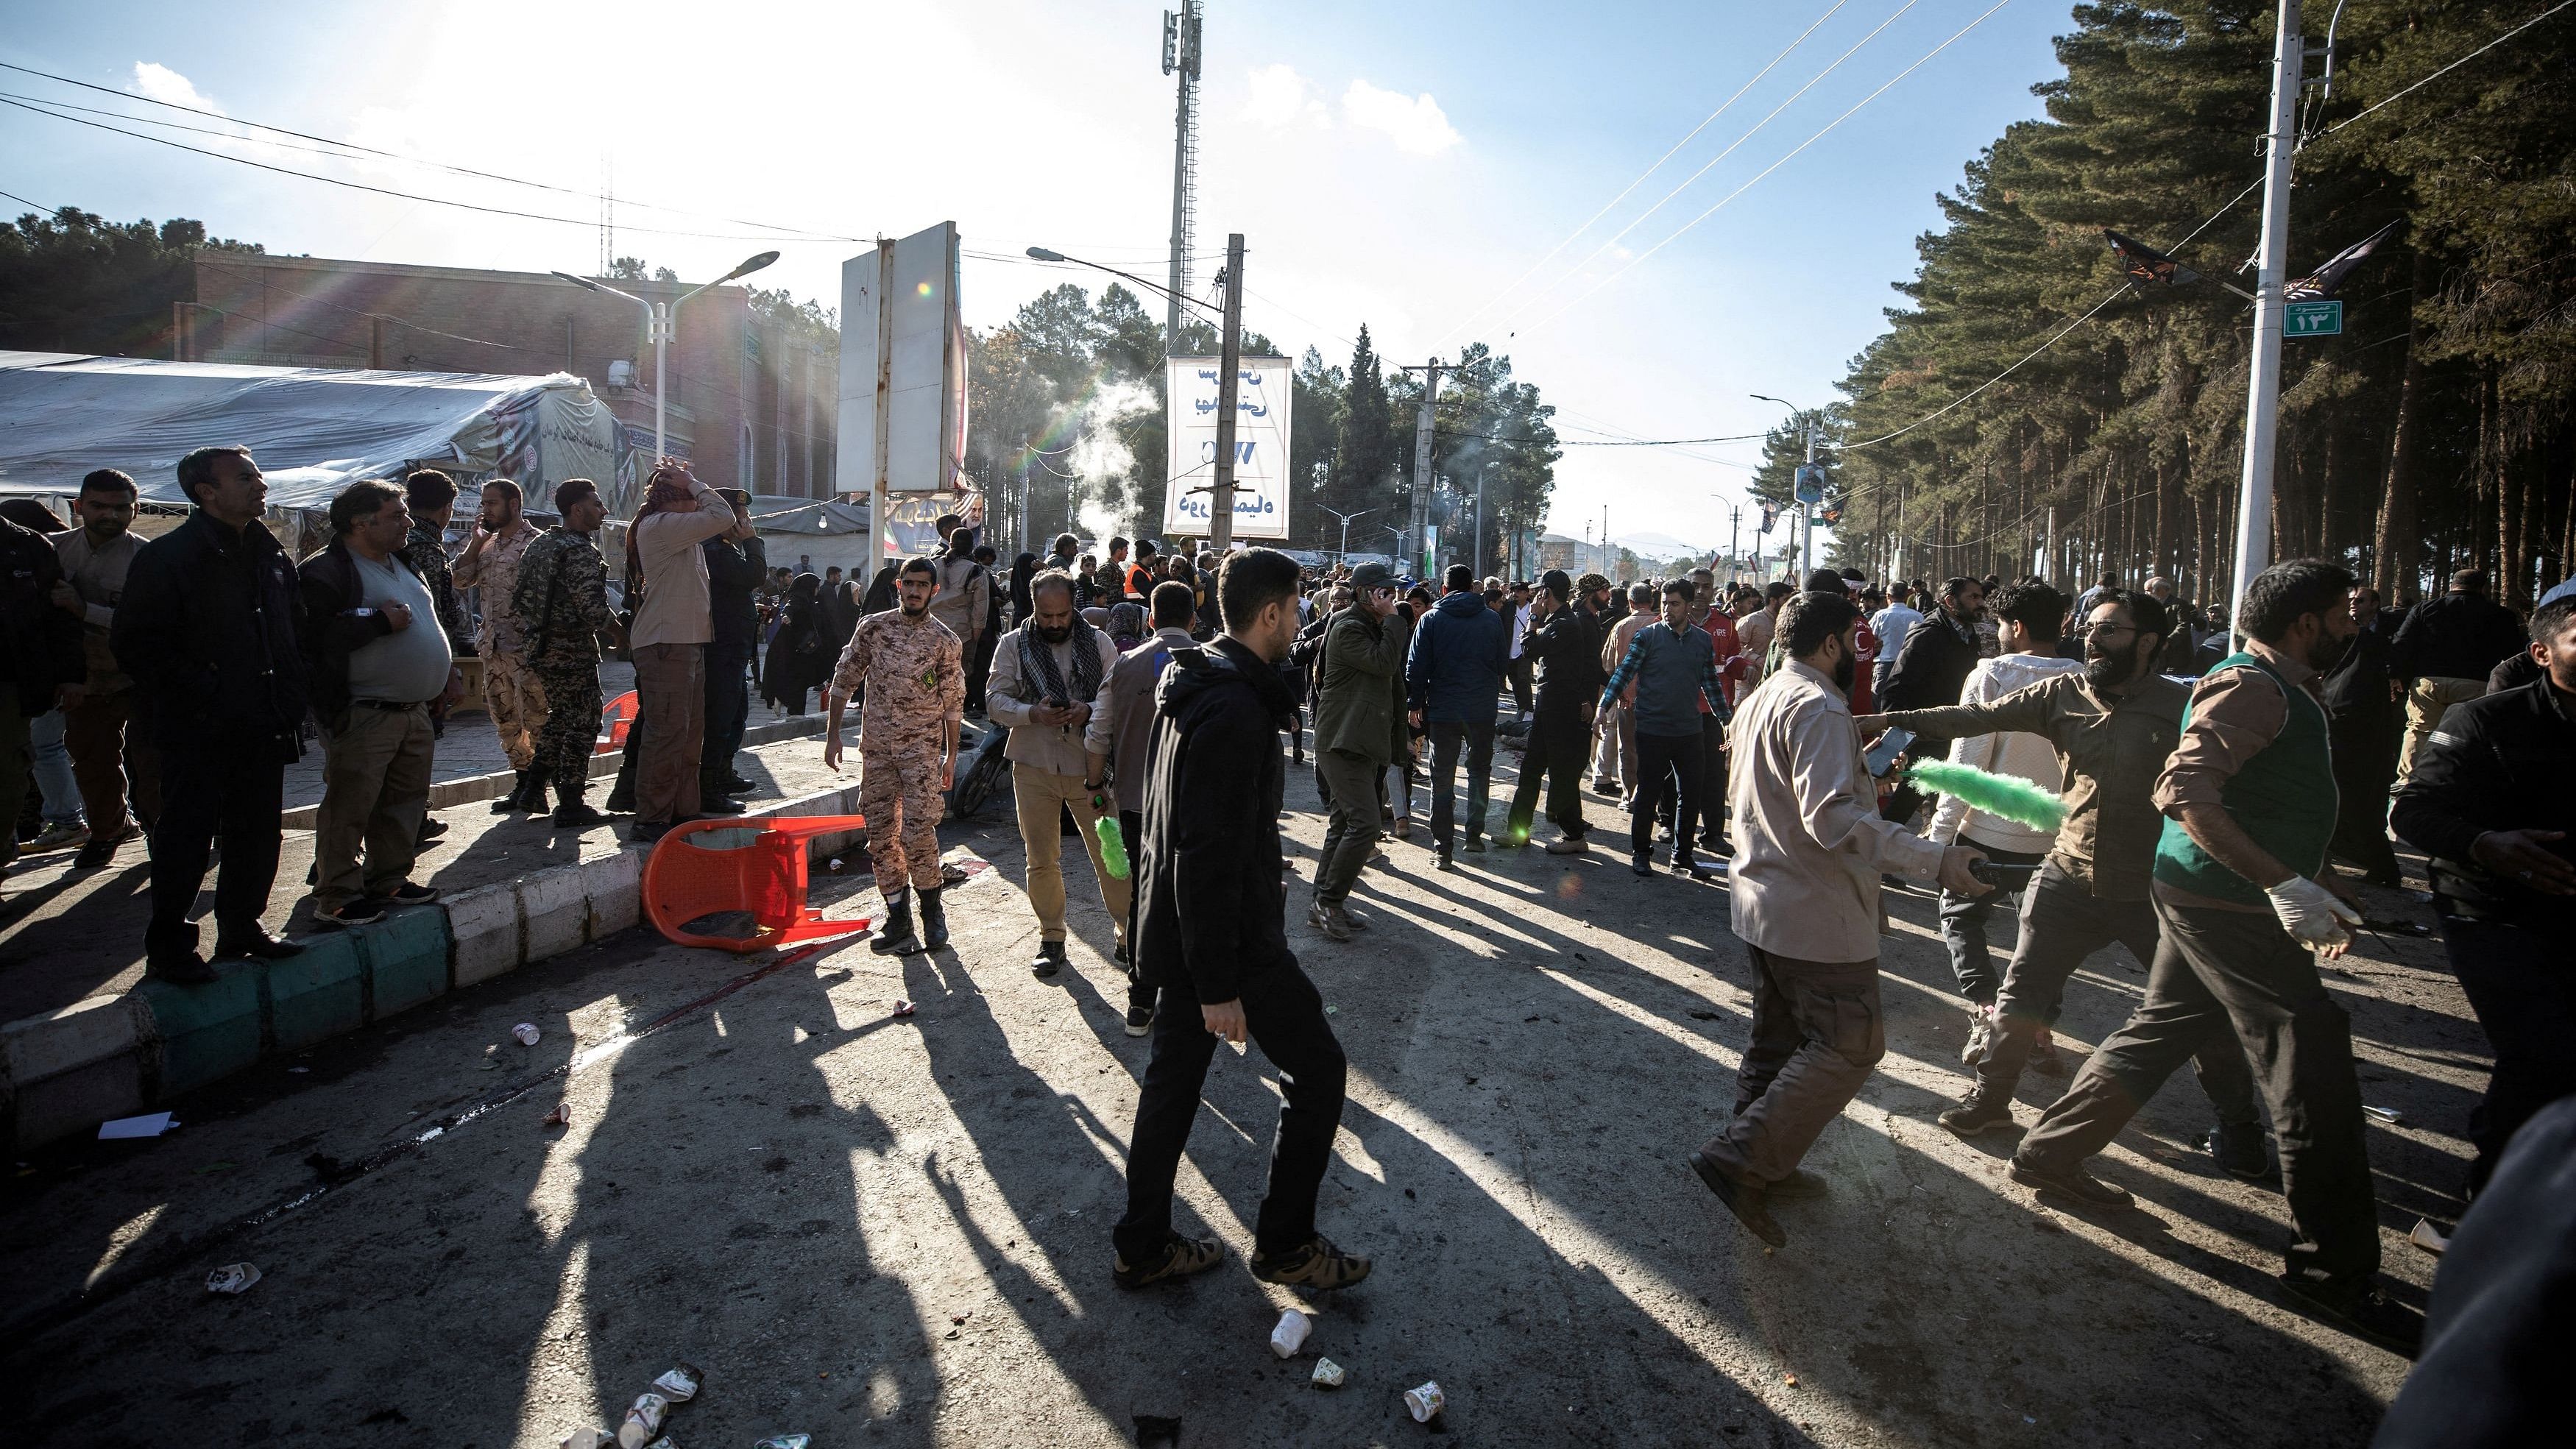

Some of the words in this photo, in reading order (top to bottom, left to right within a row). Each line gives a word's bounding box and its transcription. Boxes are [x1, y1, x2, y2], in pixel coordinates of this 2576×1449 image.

[2296, 305, 2331, 313] عمود
[2296, 313, 2329, 330] ۱۳
[894, 502, 936, 528] موکب
